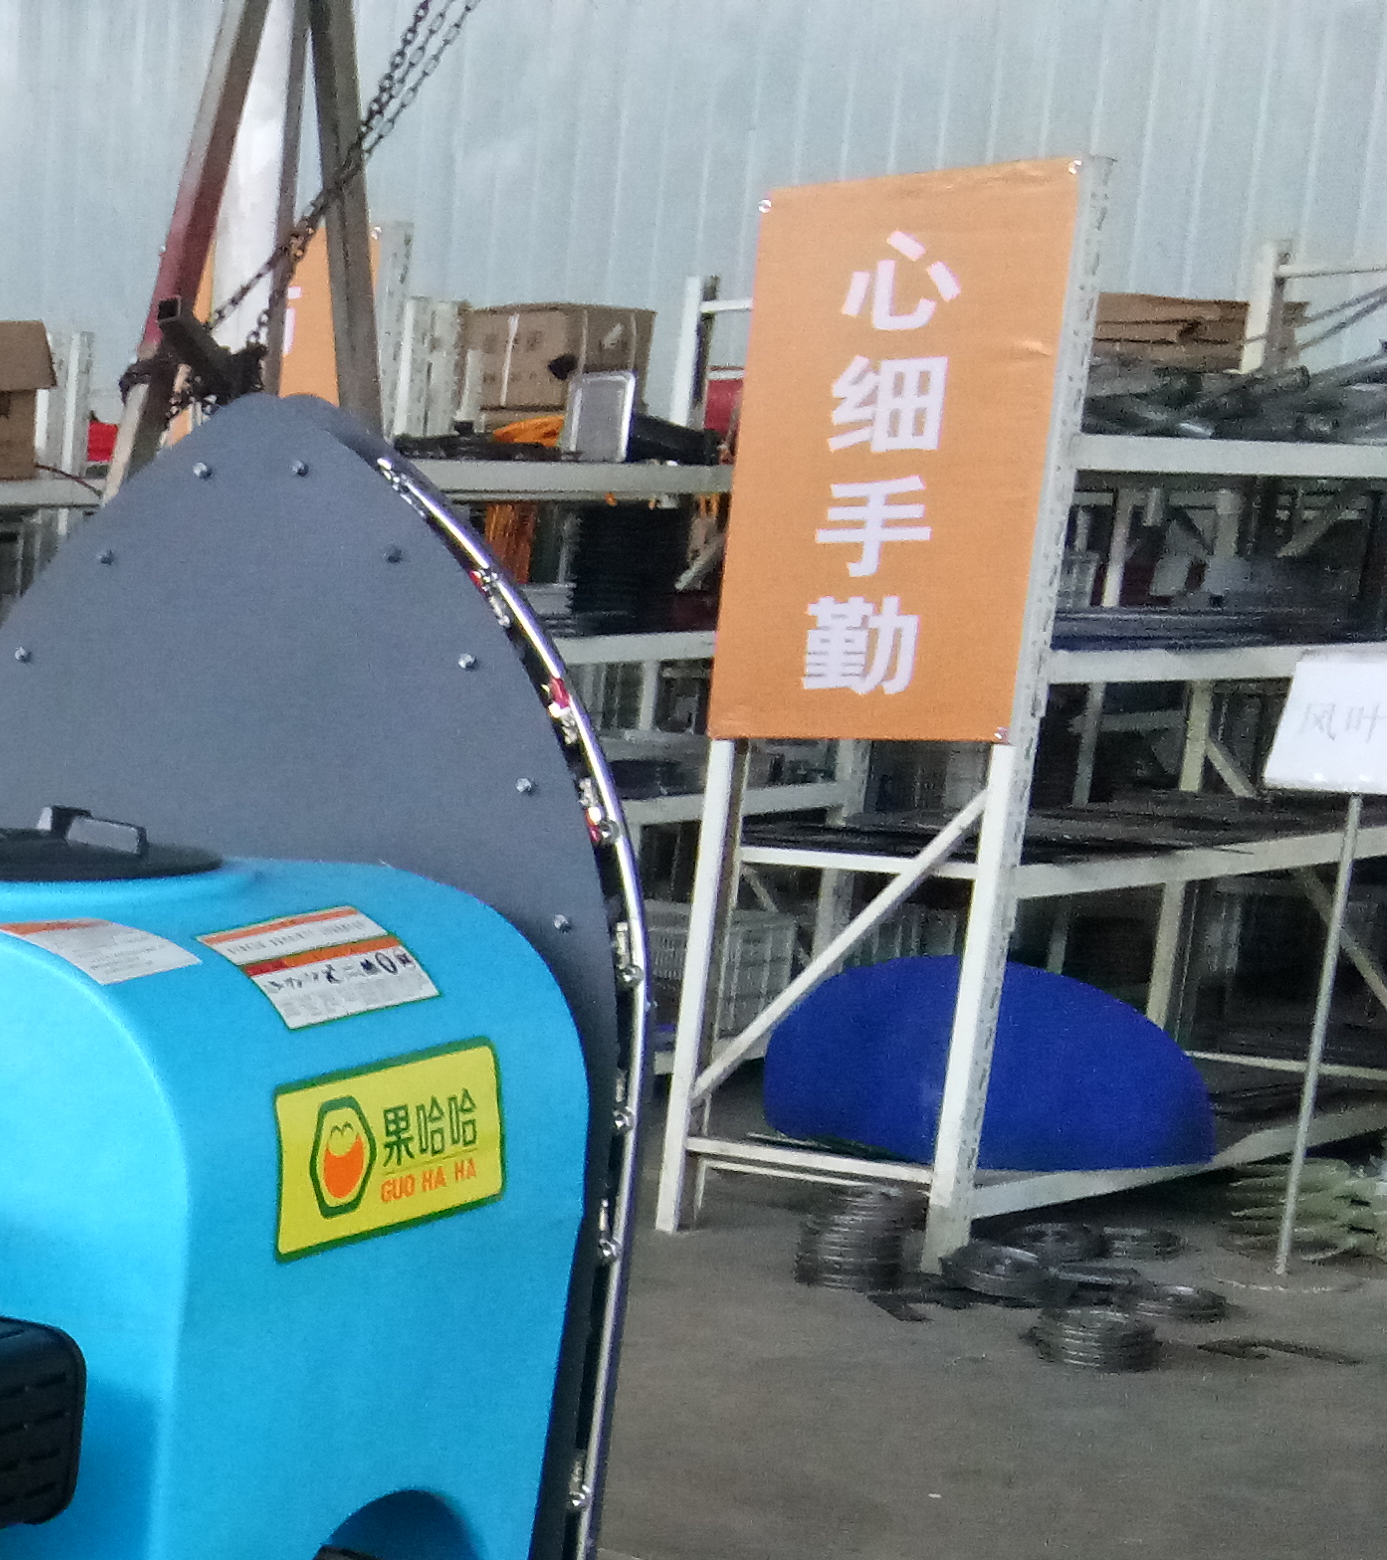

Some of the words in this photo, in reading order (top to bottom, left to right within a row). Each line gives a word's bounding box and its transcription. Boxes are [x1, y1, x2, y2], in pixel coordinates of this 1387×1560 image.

[801, 229, 961, 695] 心细手勤
[382, 1087, 477, 1168] 果哈哈
[381, 1173, 416, 1203] GUO
[422, 1166, 447, 1192] HA
[454, 1158, 477, 1182] HA
